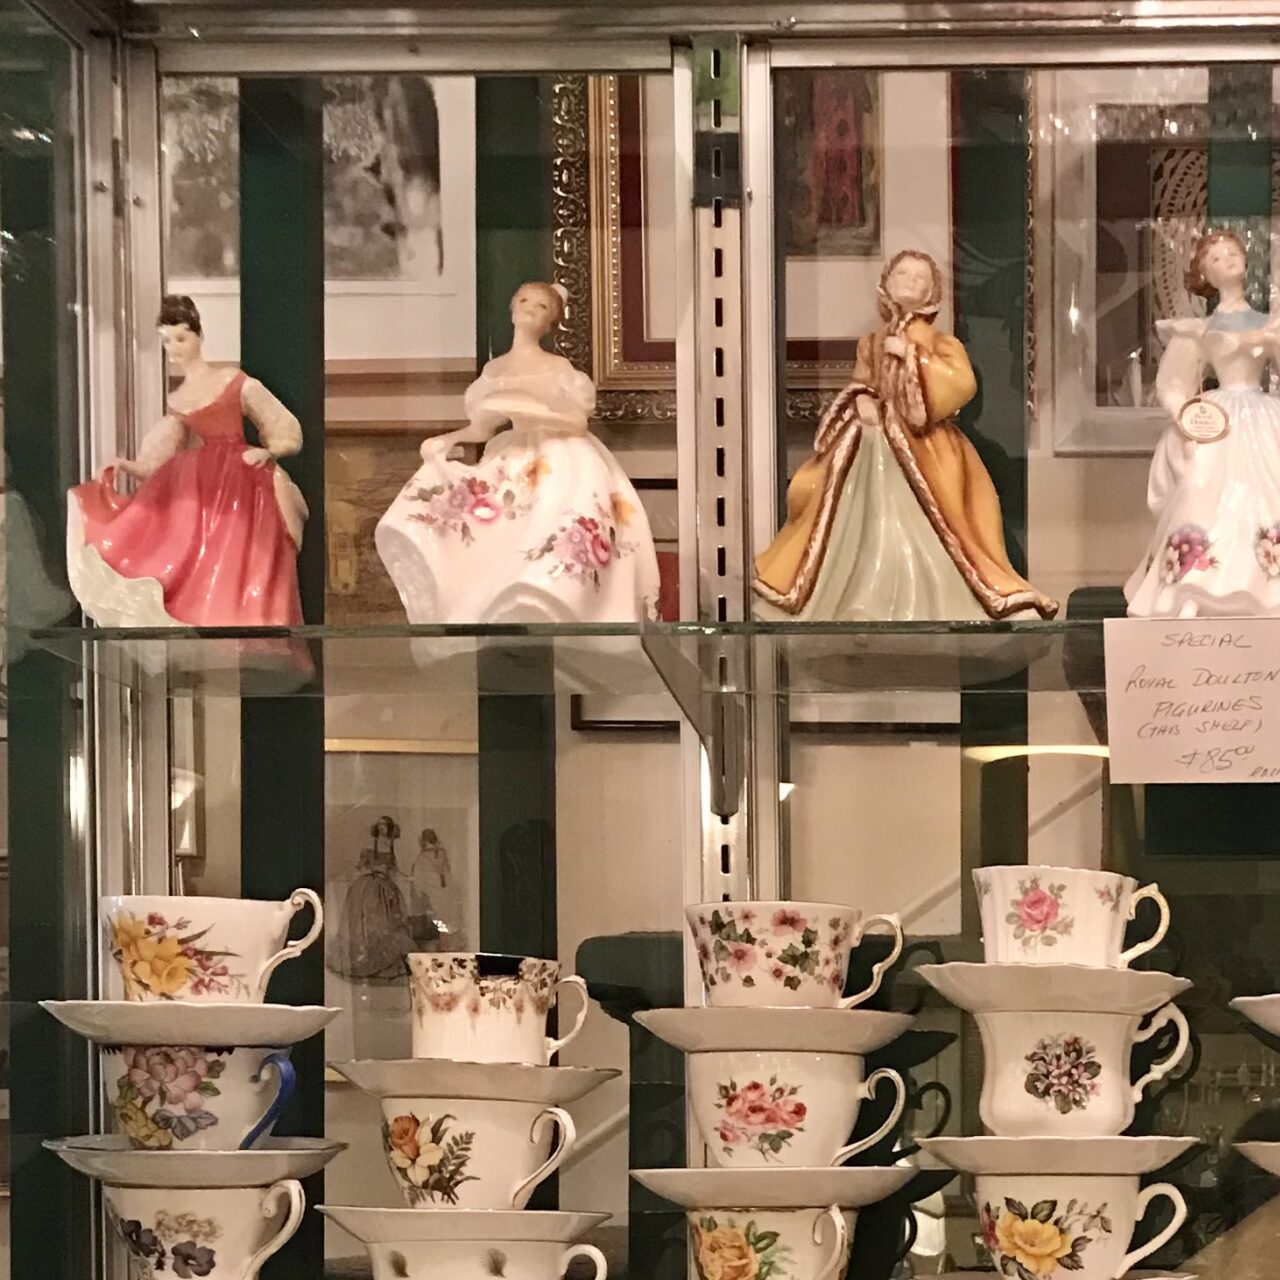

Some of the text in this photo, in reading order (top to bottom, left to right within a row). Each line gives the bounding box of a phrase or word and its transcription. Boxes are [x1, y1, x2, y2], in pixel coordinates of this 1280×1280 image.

[1161, 632, 1253, 649] SPECIAL
[1125, 664, 1178, 693] ROYAL
[1153, 695, 1265, 718] FIGURINES
